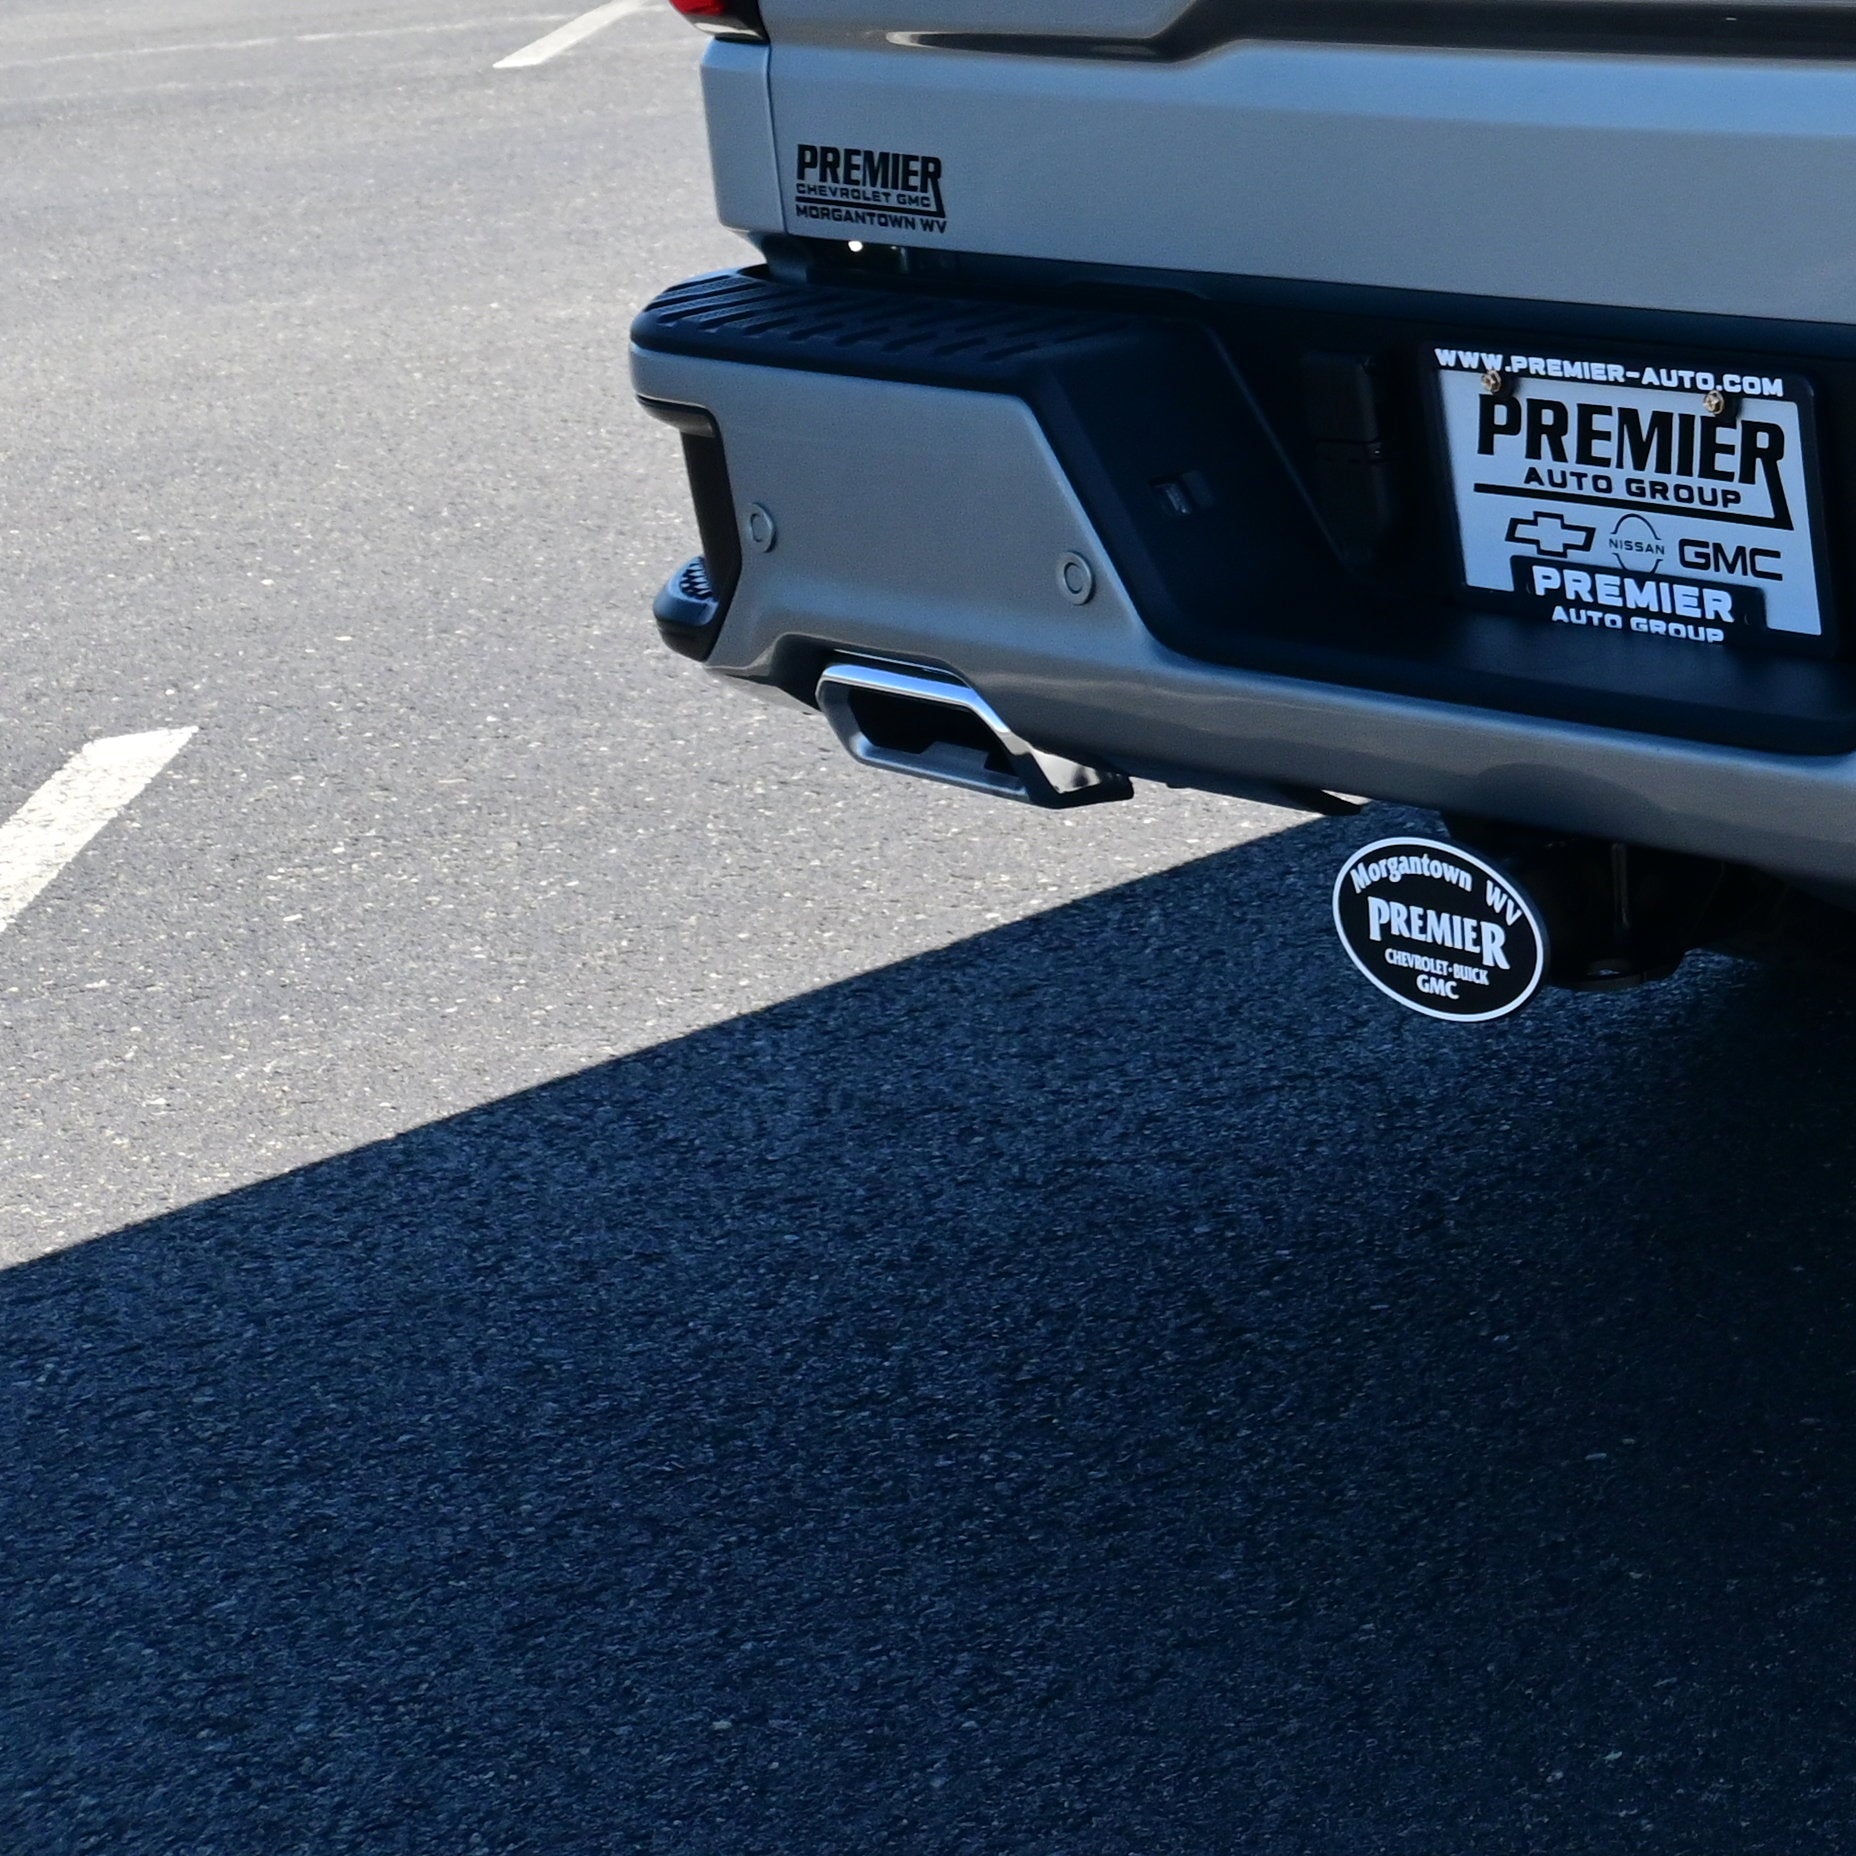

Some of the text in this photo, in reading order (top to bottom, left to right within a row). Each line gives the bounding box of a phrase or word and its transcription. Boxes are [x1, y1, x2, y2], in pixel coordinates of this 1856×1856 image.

[797, 144, 943, 194] PREMIER
[796, 182, 931, 208] CHEVROLET GMC
[795, 204, 947, 234] MORGANTOWN WV
[1434, 348, 1784, 397] WWW.PREMIER-AUTO.COM
[1477, 392, 1789, 489] PREMIER
[1524, 466, 1742, 509] AUTO GROUP
[1608, 537, 1665, 556] NISSAN
[1678, 538, 1783, 581] GMC
[1532, 565, 1735, 623] PREMIER
[1551, 605, 1725, 644] AUTO GROUP
[1350, 853, 1522, 927] Morgantown WV
[1367, 896, 1511, 970] PREMIER
[1416, 974, 1459, 1000] GMC
